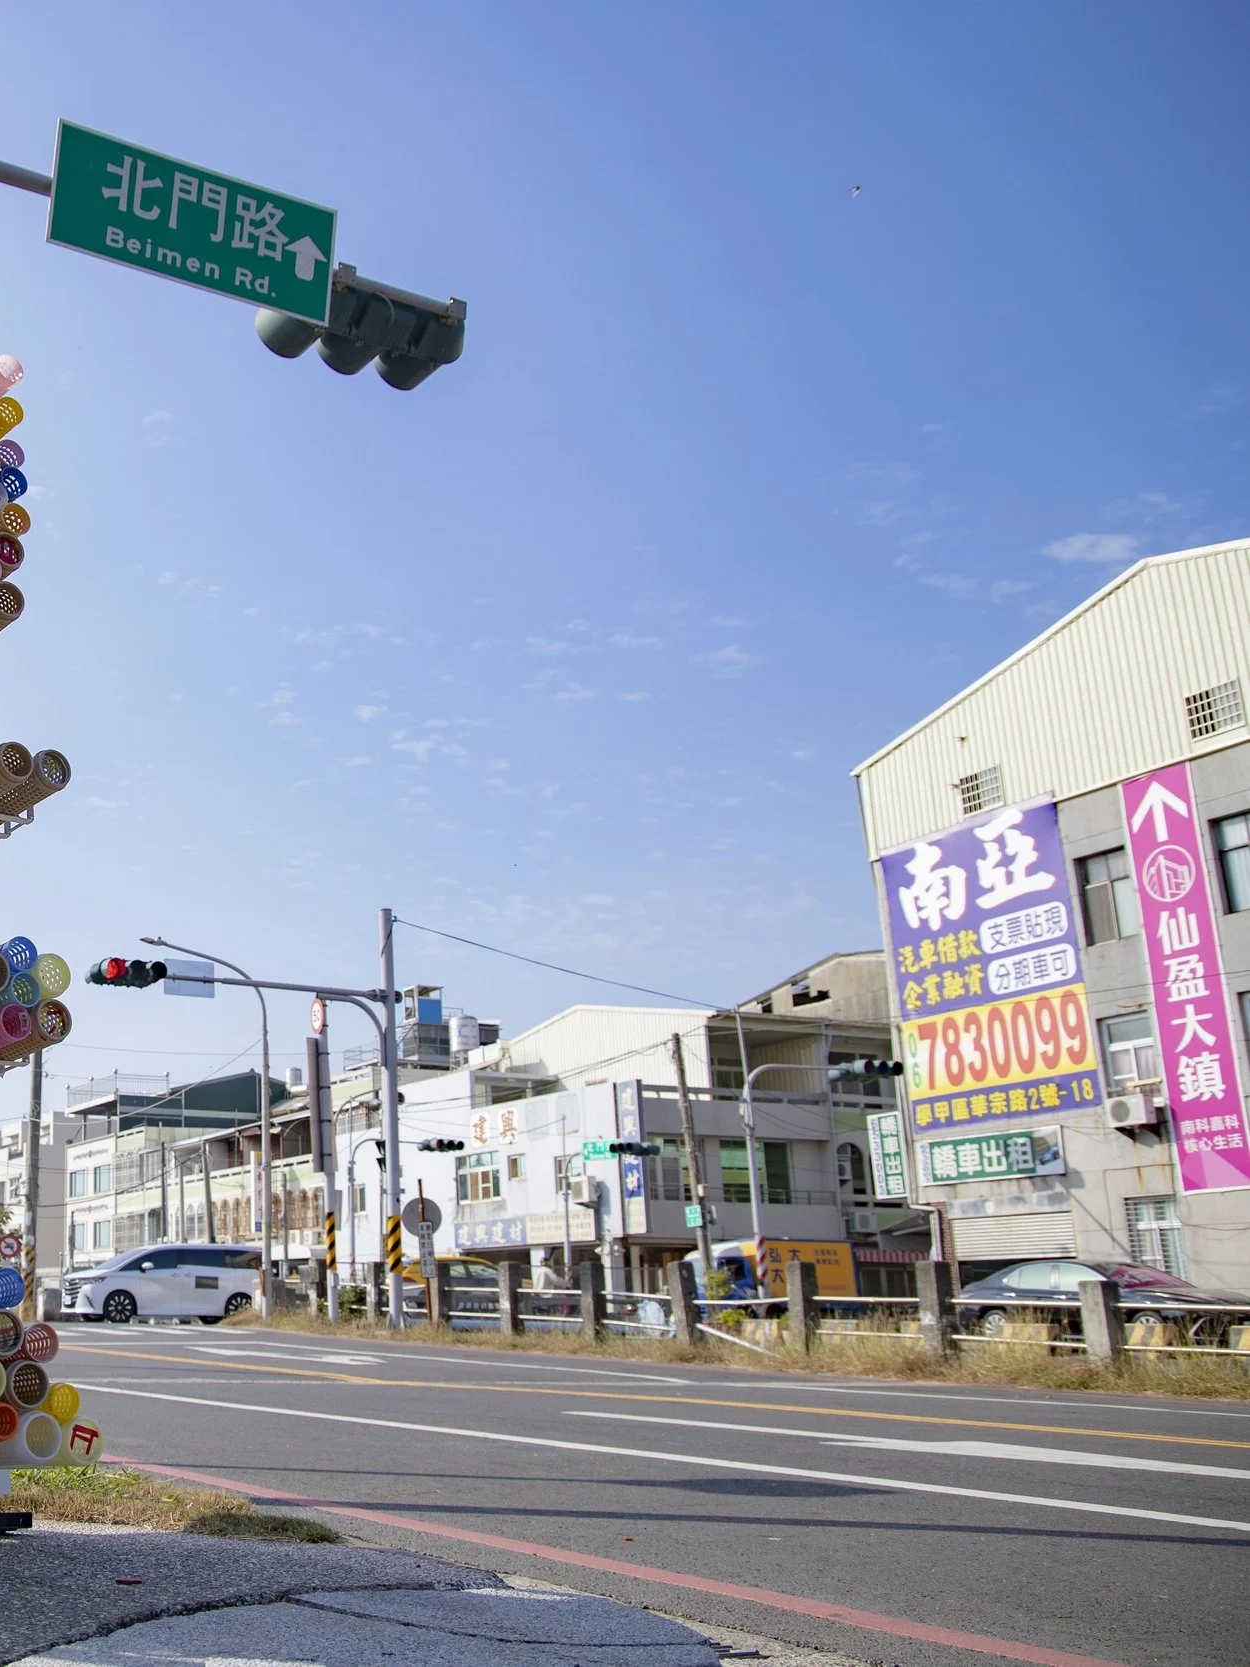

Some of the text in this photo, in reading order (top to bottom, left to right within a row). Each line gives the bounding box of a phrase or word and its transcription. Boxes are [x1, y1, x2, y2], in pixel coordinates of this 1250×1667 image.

[101, 154, 289, 263] 北門路
[105, 226, 277, 297] Beimen Rd.
[987, 904, 1064, 951] 支票貼現
[898, 929, 983, 974] 汽車借款
[994, 948, 1069, 992] 分期車可
[902, 963, 985, 1010] 企業融資
[1155, 906, 1226, 1103] 仙盈大鎮
[918, 989, 1088, 1091] 7830099
[931, 1136, 1035, 1179] 轎車出租
